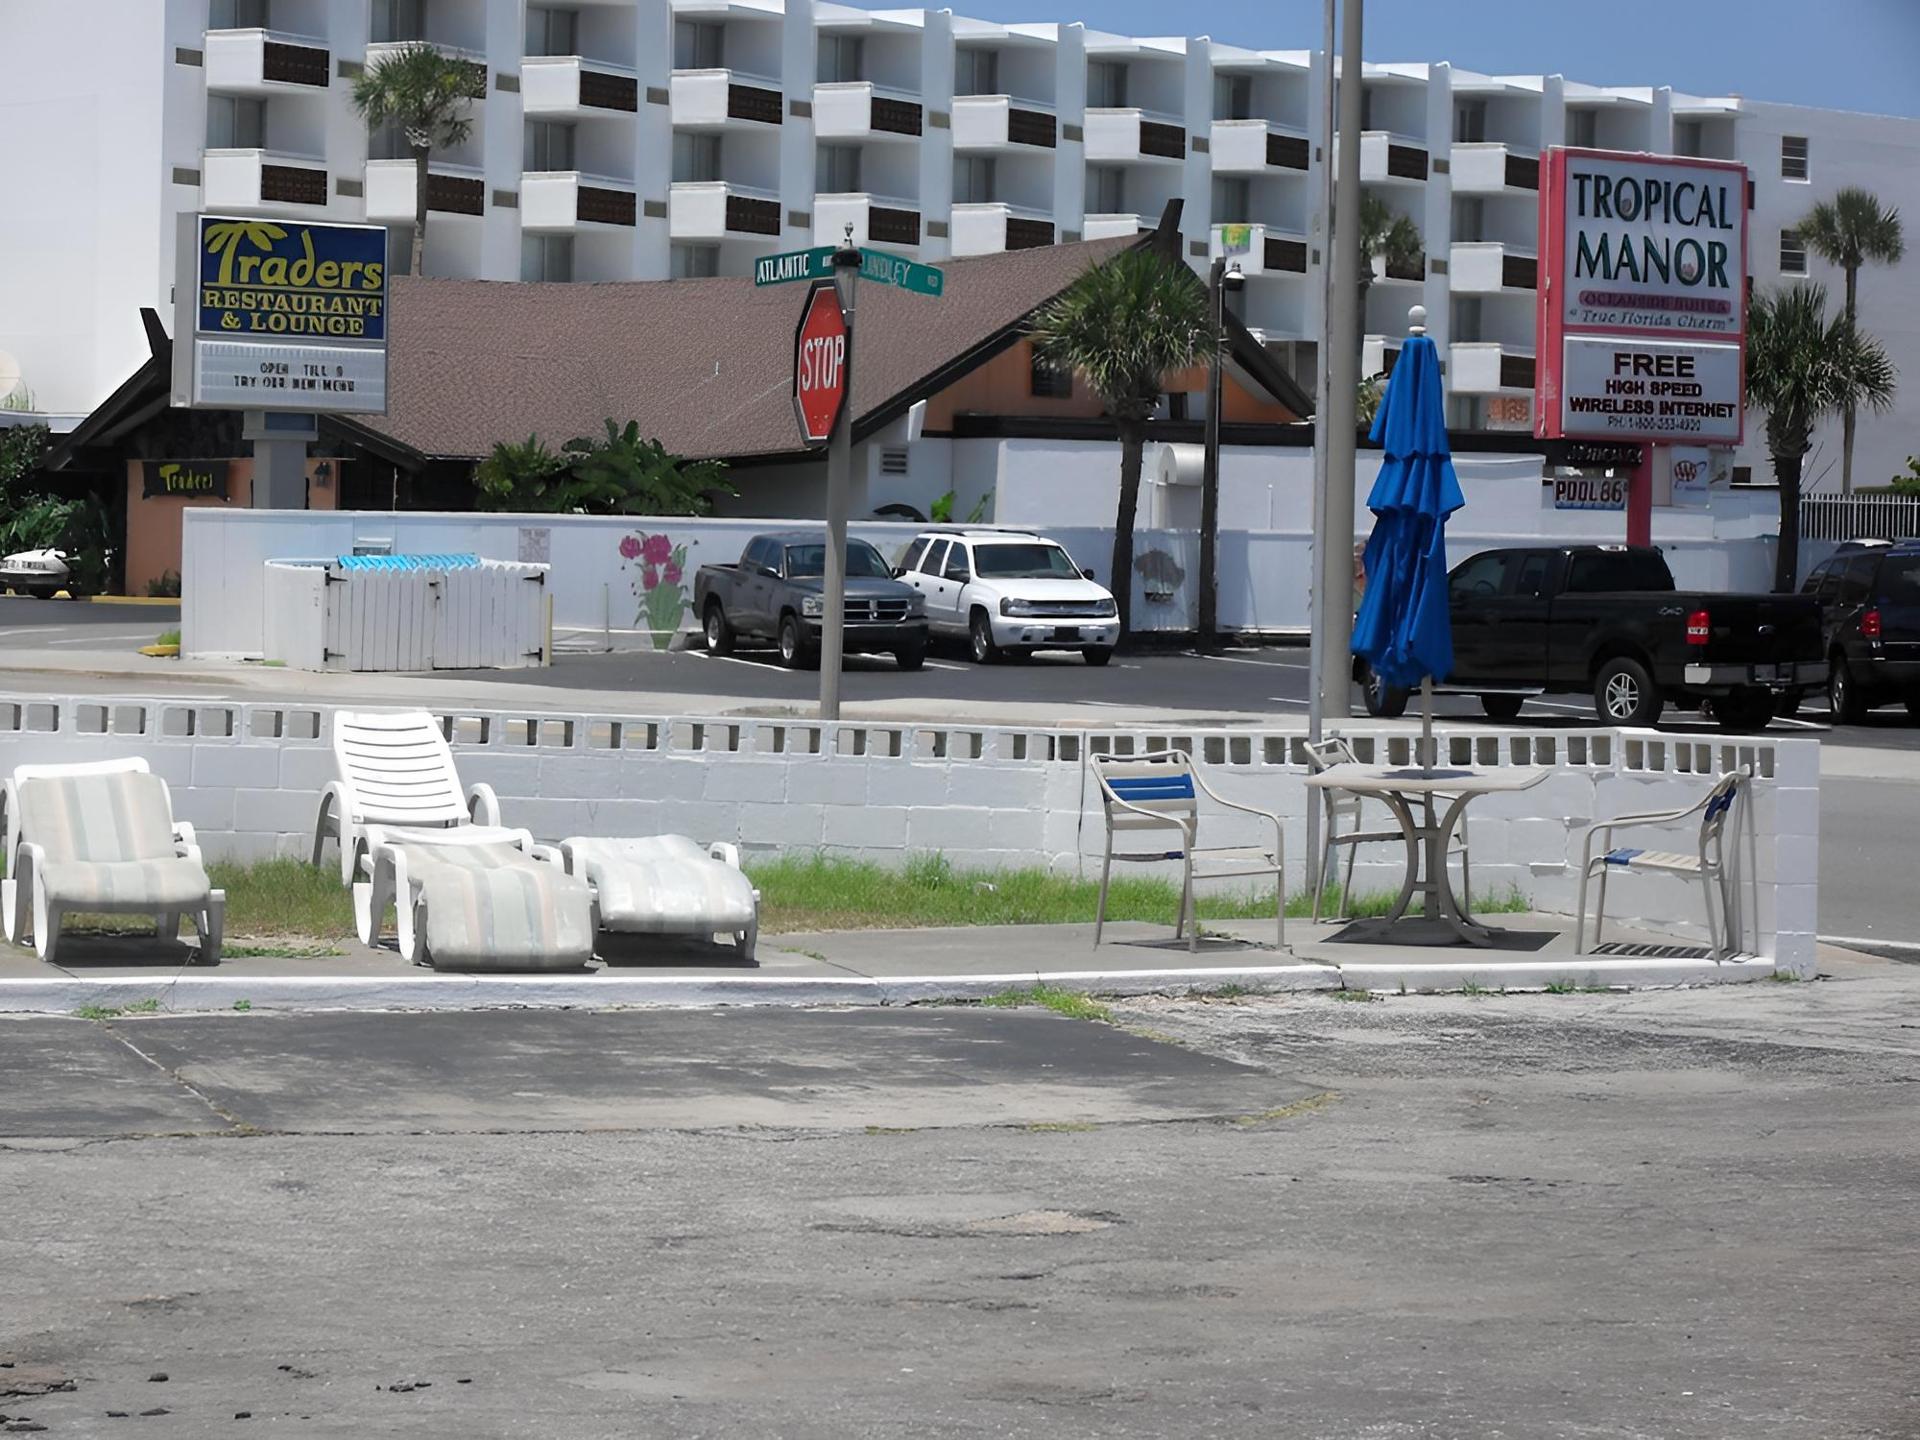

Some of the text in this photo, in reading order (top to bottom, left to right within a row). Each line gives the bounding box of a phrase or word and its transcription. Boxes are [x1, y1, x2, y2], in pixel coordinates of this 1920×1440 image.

[1573, 173, 1733, 230] TROPICAL
[204, 221, 383, 290] Traders
[1575, 231, 1730, 288] MANOR
[756, 253, 810, 283] ATLANTIC
[202, 290, 382, 316] RESTAURANT
[221, 312, 364, 336] & LOUNGE
[1620, 311, 1672, 327] Florida
[260, 362, 289, 375] OPEN
[801, 335, 845, 391] STOP
[1614, 353, 1695, 378] FREE
[234, 375, 256, 387] TRY
[1606, 379, 1702, 397] HIGH SPEED
[1569, 396, 1736, 418] WIRELESS INTERNET
[1555, 480, 1598, 502] POOL
